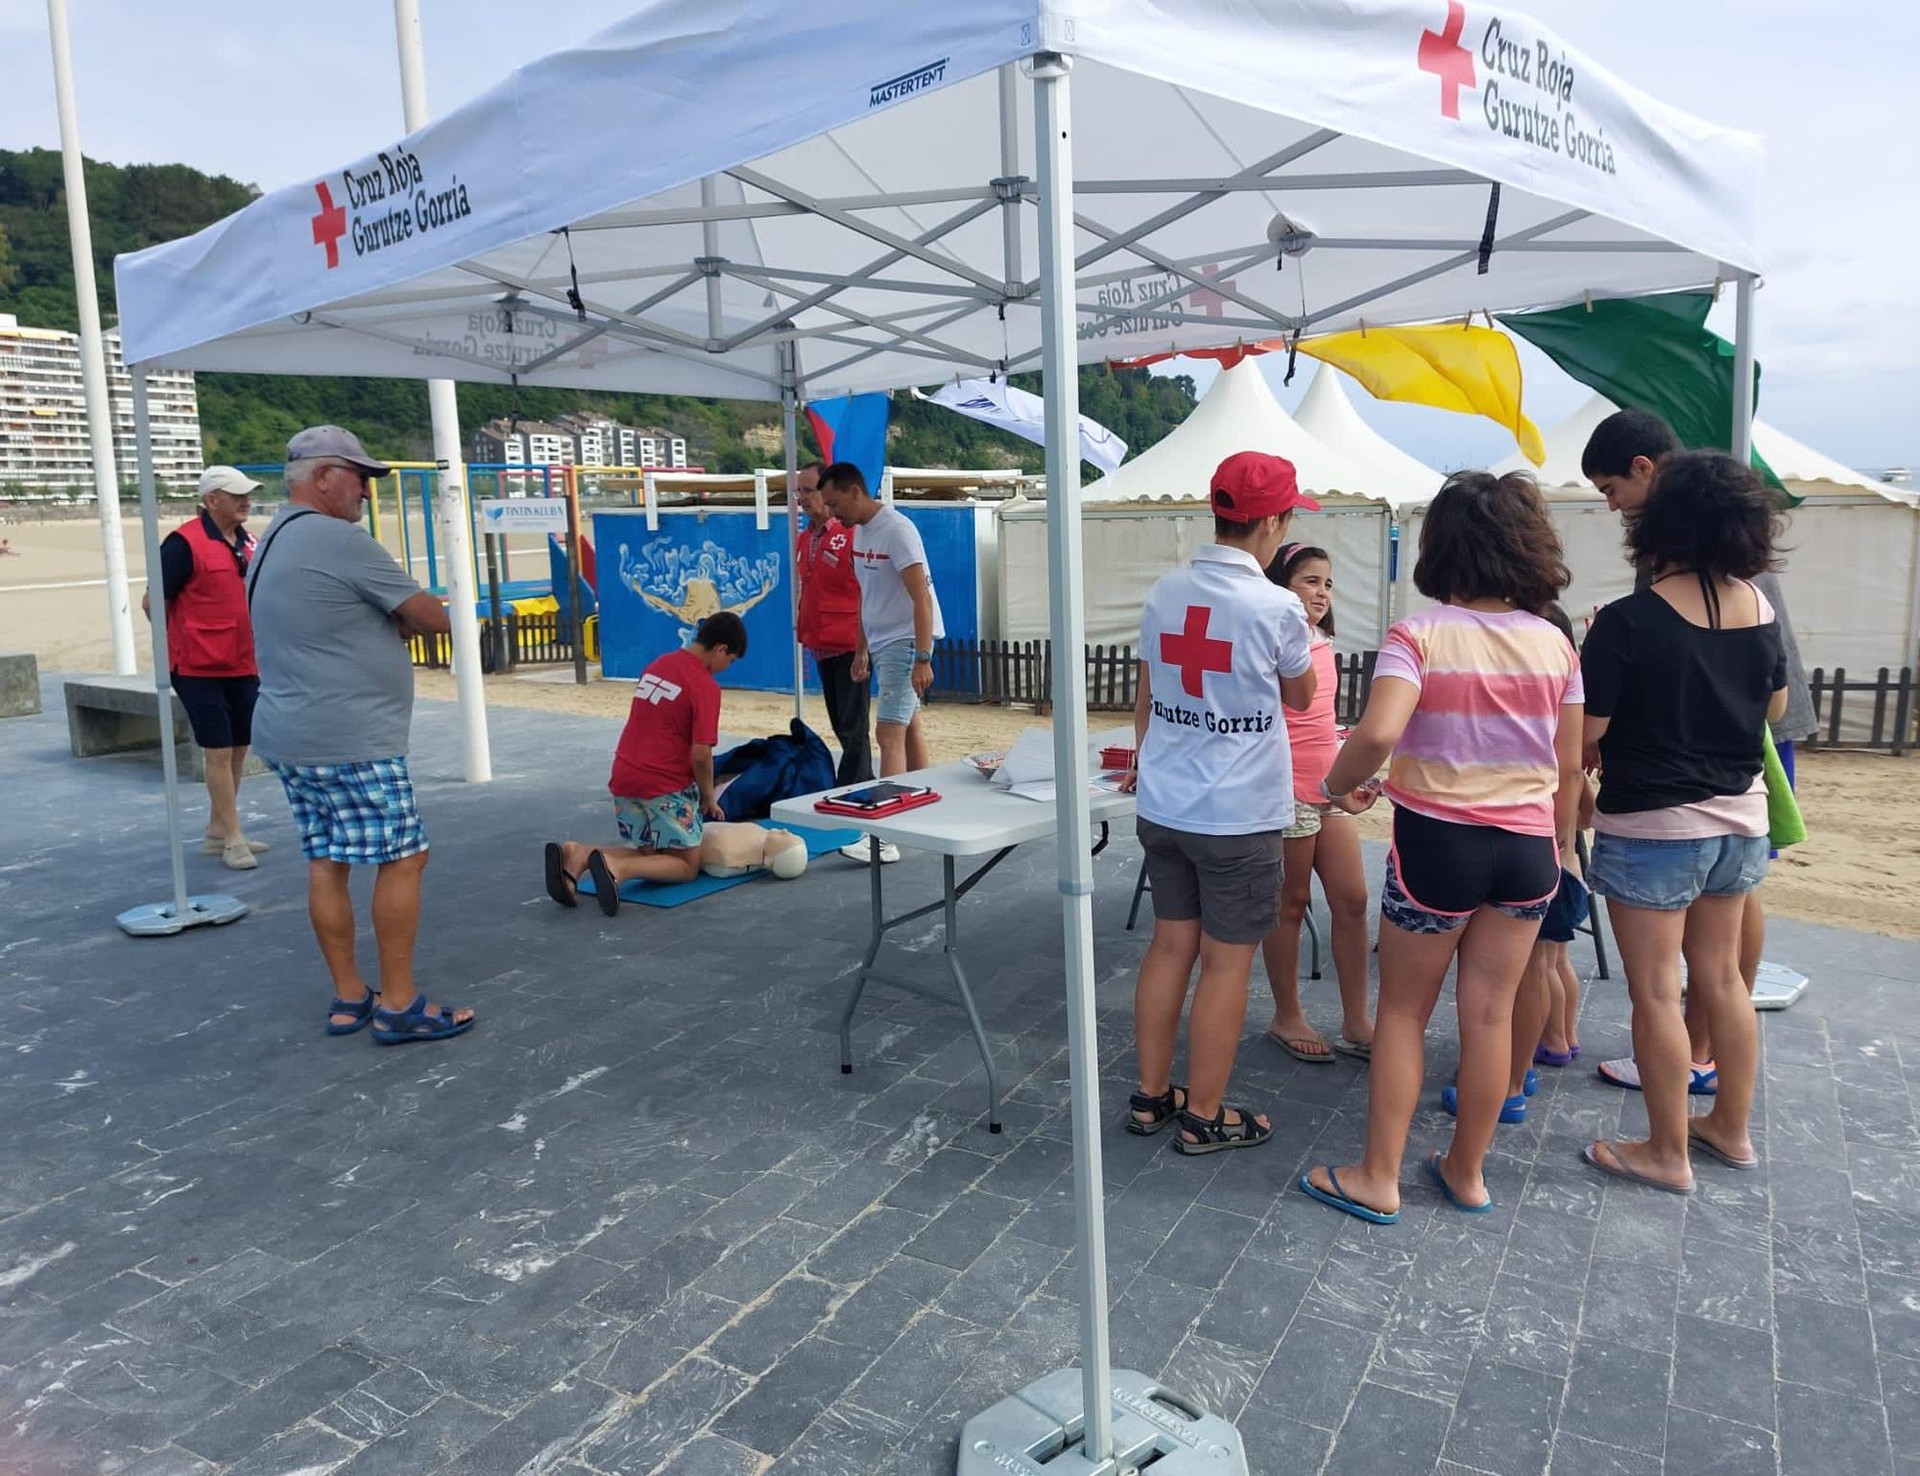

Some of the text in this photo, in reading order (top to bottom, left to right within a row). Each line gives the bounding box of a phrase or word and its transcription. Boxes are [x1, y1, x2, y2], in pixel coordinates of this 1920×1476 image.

[869, 64, 946, 107] MASTERTENT
[1482, 16, 1574, 112] Cruz Roja
[1484, 79, 1616, 175] Gurutze Gorria
[343, 144, 423, 210] Cruz Roja
[352, 174, 471, 256] Gurutze Gorria
[1150, 694, 1273, 735] uutze Gorria
